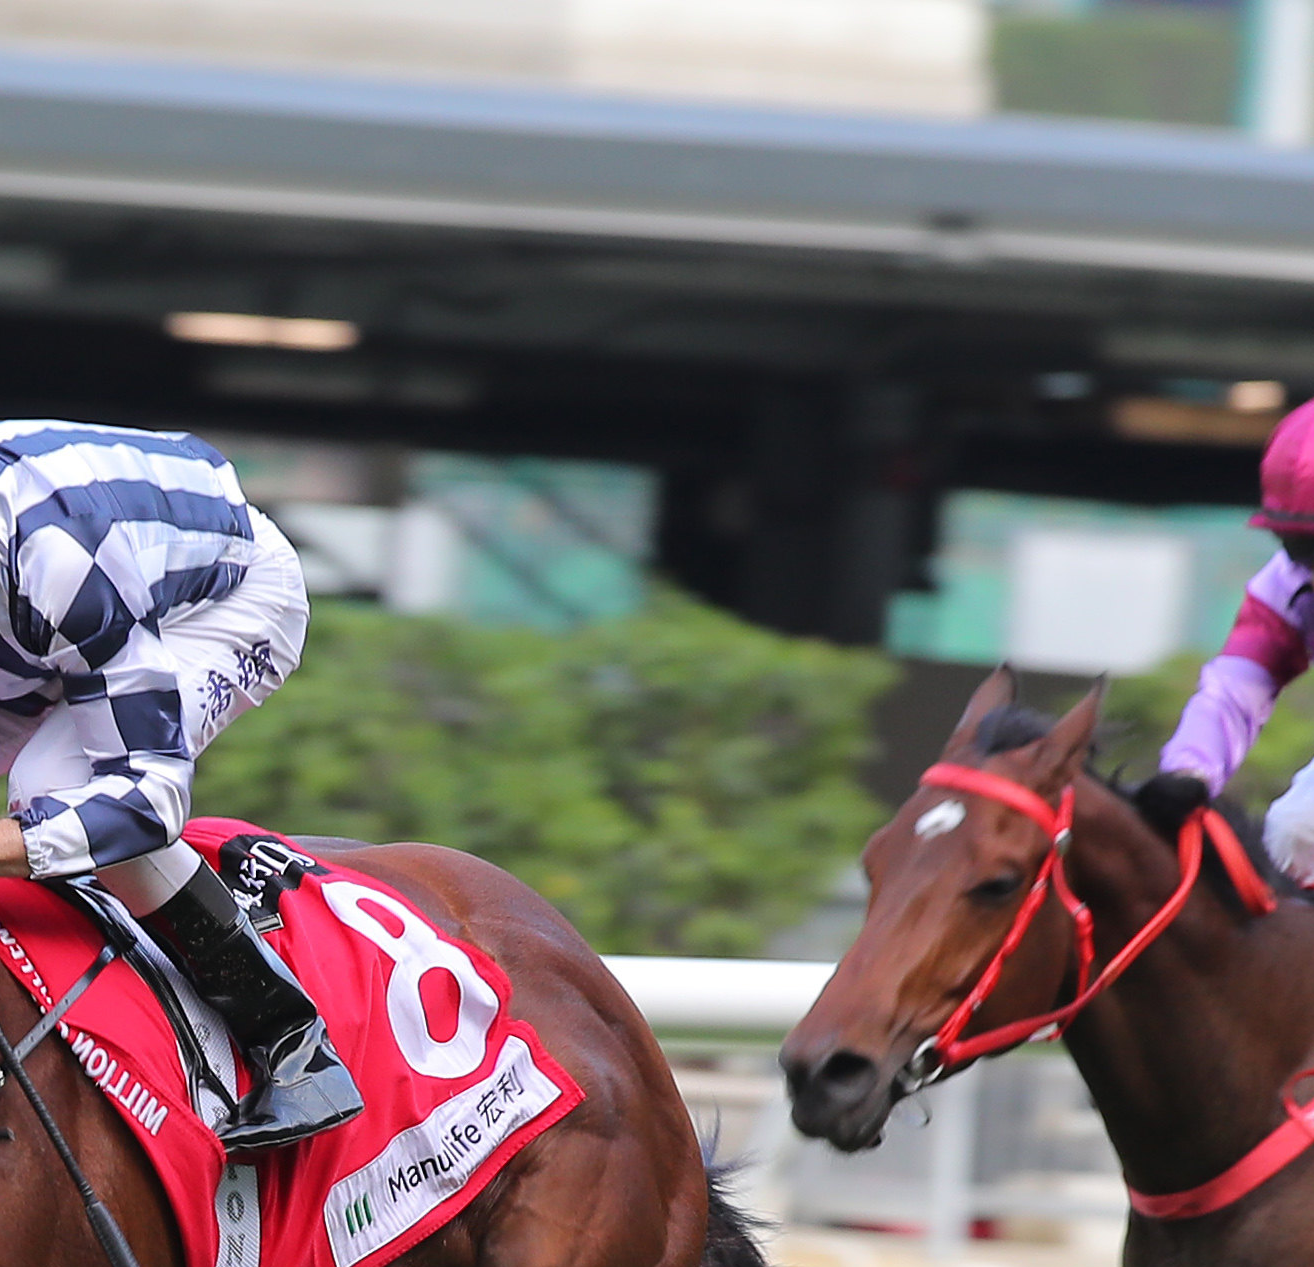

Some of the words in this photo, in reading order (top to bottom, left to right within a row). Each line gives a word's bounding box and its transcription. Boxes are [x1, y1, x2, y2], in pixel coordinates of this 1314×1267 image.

[321, 881, 500, 1079] 8
[388, 1125, 482, 1203] Manulife
[476, 1065, 525, 1128] 宏利
